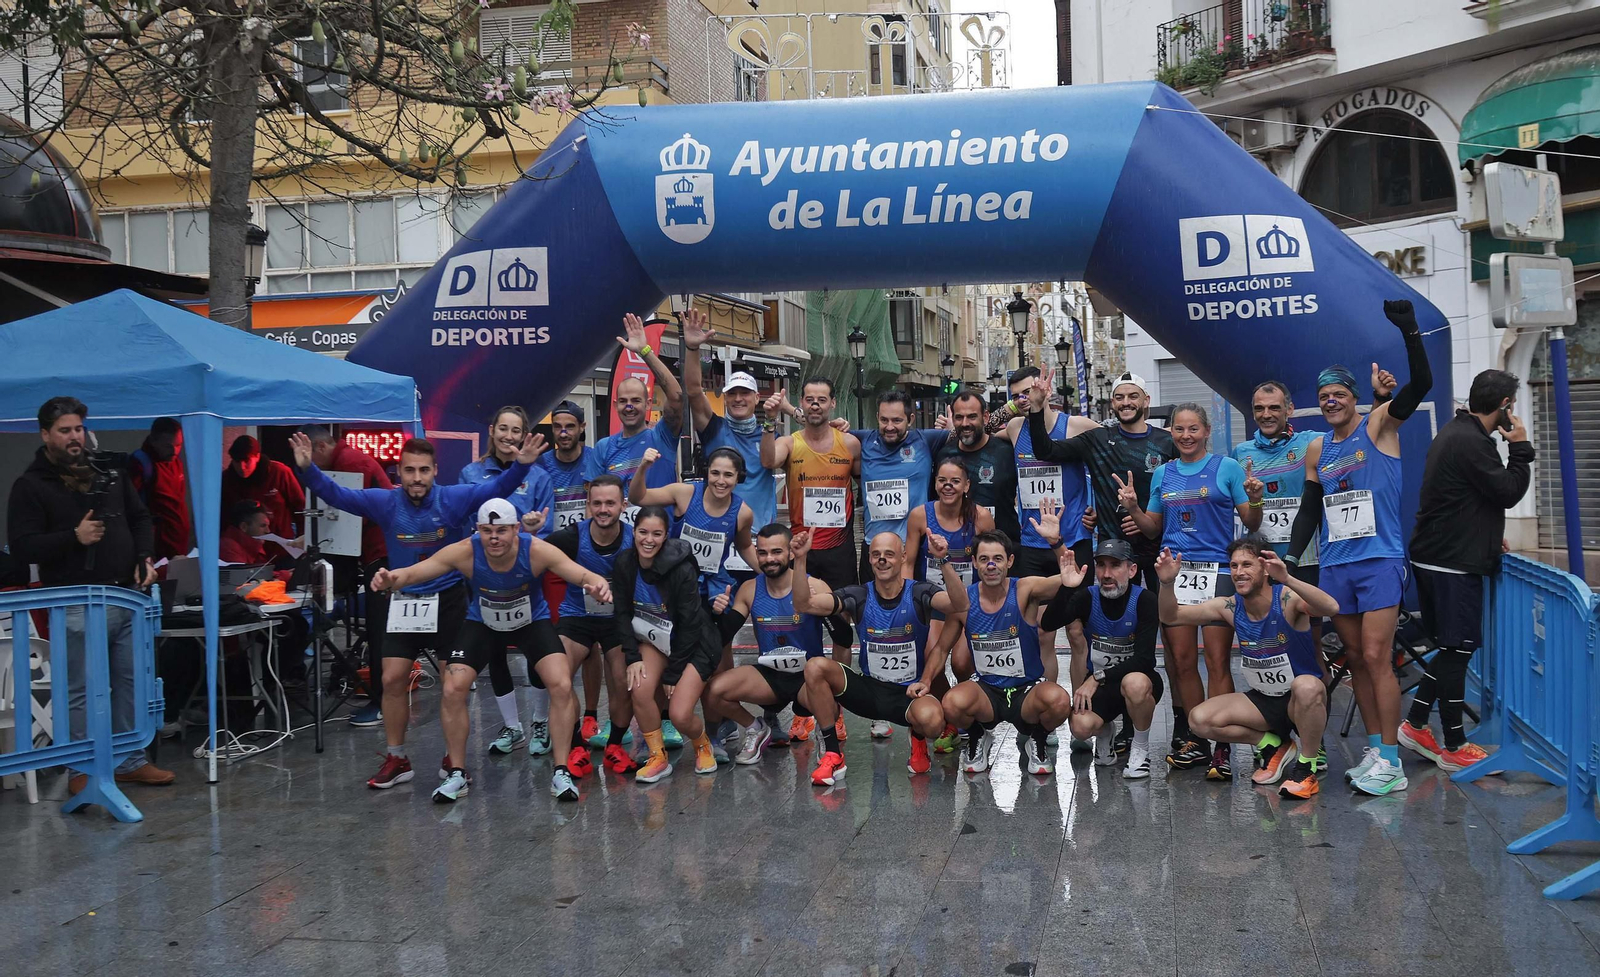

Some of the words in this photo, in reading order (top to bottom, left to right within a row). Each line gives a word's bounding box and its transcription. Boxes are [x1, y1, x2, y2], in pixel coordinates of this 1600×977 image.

[728, 128, 1069, 187] Ayuntamiento
[768, 189, 824, 230] de
[835, 189, 891, 227] La
[902, 183, 1033, 224] Línea
[1196, 230, 1231, 268] D
[448, 265, 477, 296] D
[1184, 277, 1271, 295] DELEGACIÓN
[1273, 276, 1292, 288] DE
[432, 308, 507, 321] DELEGACIÓN
[510, 309, 528, 320] DE
[1187, 294, 1319, 321] DEPORTES
[312, 330, 357, 348] Copas
[431, 326, 551, 346] DEPORTES
[1030, 479, 1056, 494] 104
[815, 500, 841, 514] 296
[876, 491, 902, 507] 208
[559, 512, 585, 527] 263
[1268, 512, 1289, 528] 93
[1341, 505, 1360, 523] 77
[1178, 574, 1208, 591] 243
[401, 602, 431, 618] 117
[494, 608, 524, 622] 116
[647, 629, 656, 642] 6
[772, 658, 800, 669] 112
[880, 655, 910, 670] 225
[985, 652, 1016, 668] 266
[1256, 669, 1287, 685] 186
